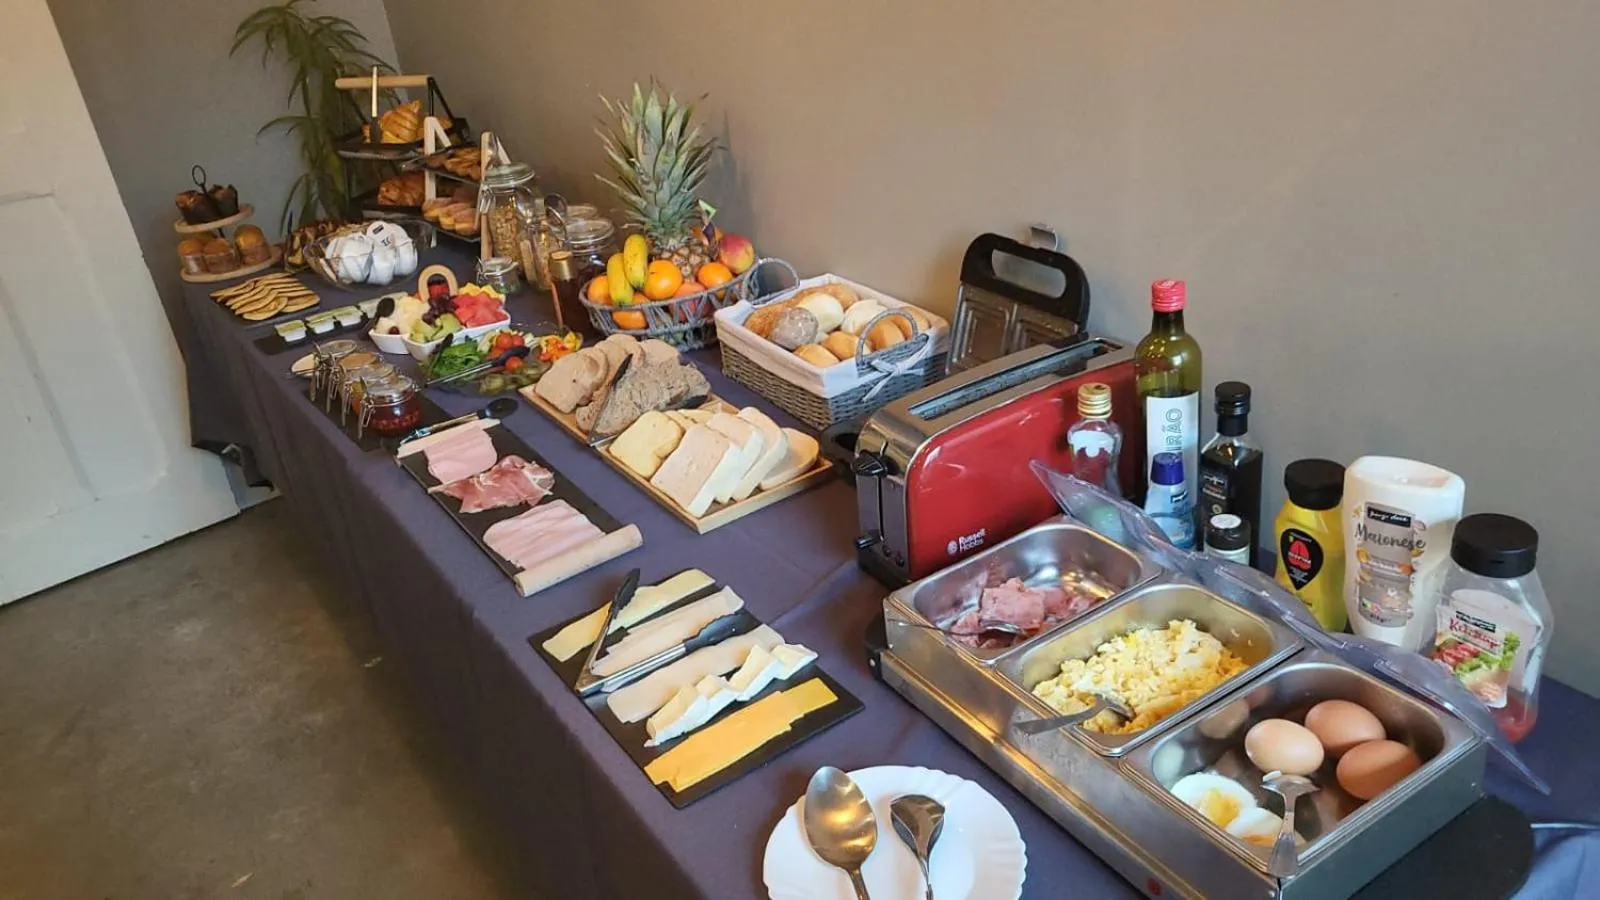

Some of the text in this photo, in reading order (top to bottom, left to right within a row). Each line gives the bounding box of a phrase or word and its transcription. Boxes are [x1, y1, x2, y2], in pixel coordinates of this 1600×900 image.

[1161, 408, 1183, 455] IRÃO
[959, 528, 985, 544] Russell
[1355, 523, 1426, 551] Maionese
